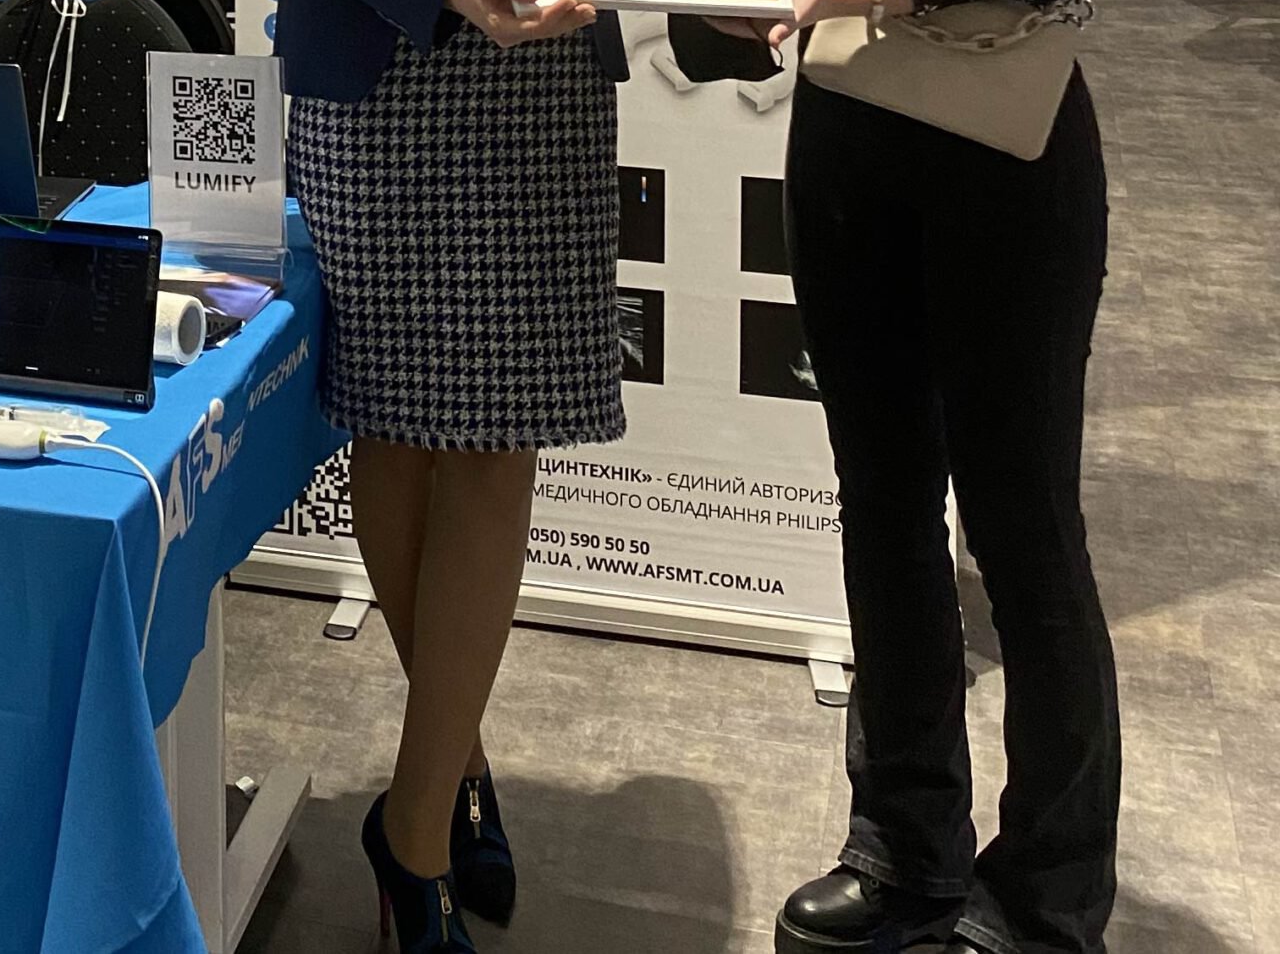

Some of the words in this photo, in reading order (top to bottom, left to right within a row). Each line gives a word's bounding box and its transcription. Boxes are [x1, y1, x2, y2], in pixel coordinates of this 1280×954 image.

[175, 171, 257, 194] LUMIFY
[537, 457, 653, 484] ЦИНТЕХНІК»
[666, 472, 746, 496] ЄДИНИЙ
[533, 483, 642, 510] МЕДИЧНОГО
[647, 496, 771, 525] ОБЛАДНАННЯ
[776, 511, 842, 533] PHILIPS
[530, 527, 566, 547] 050)
[570, 532, 600, 549] 590
[604, 536, 625, 552] 50
[629, 539, 651, 555] 50
[525, 548, 573, 568] M.UA
[586, 555, 785, 595] WWW.AFSMT.COM.UA
